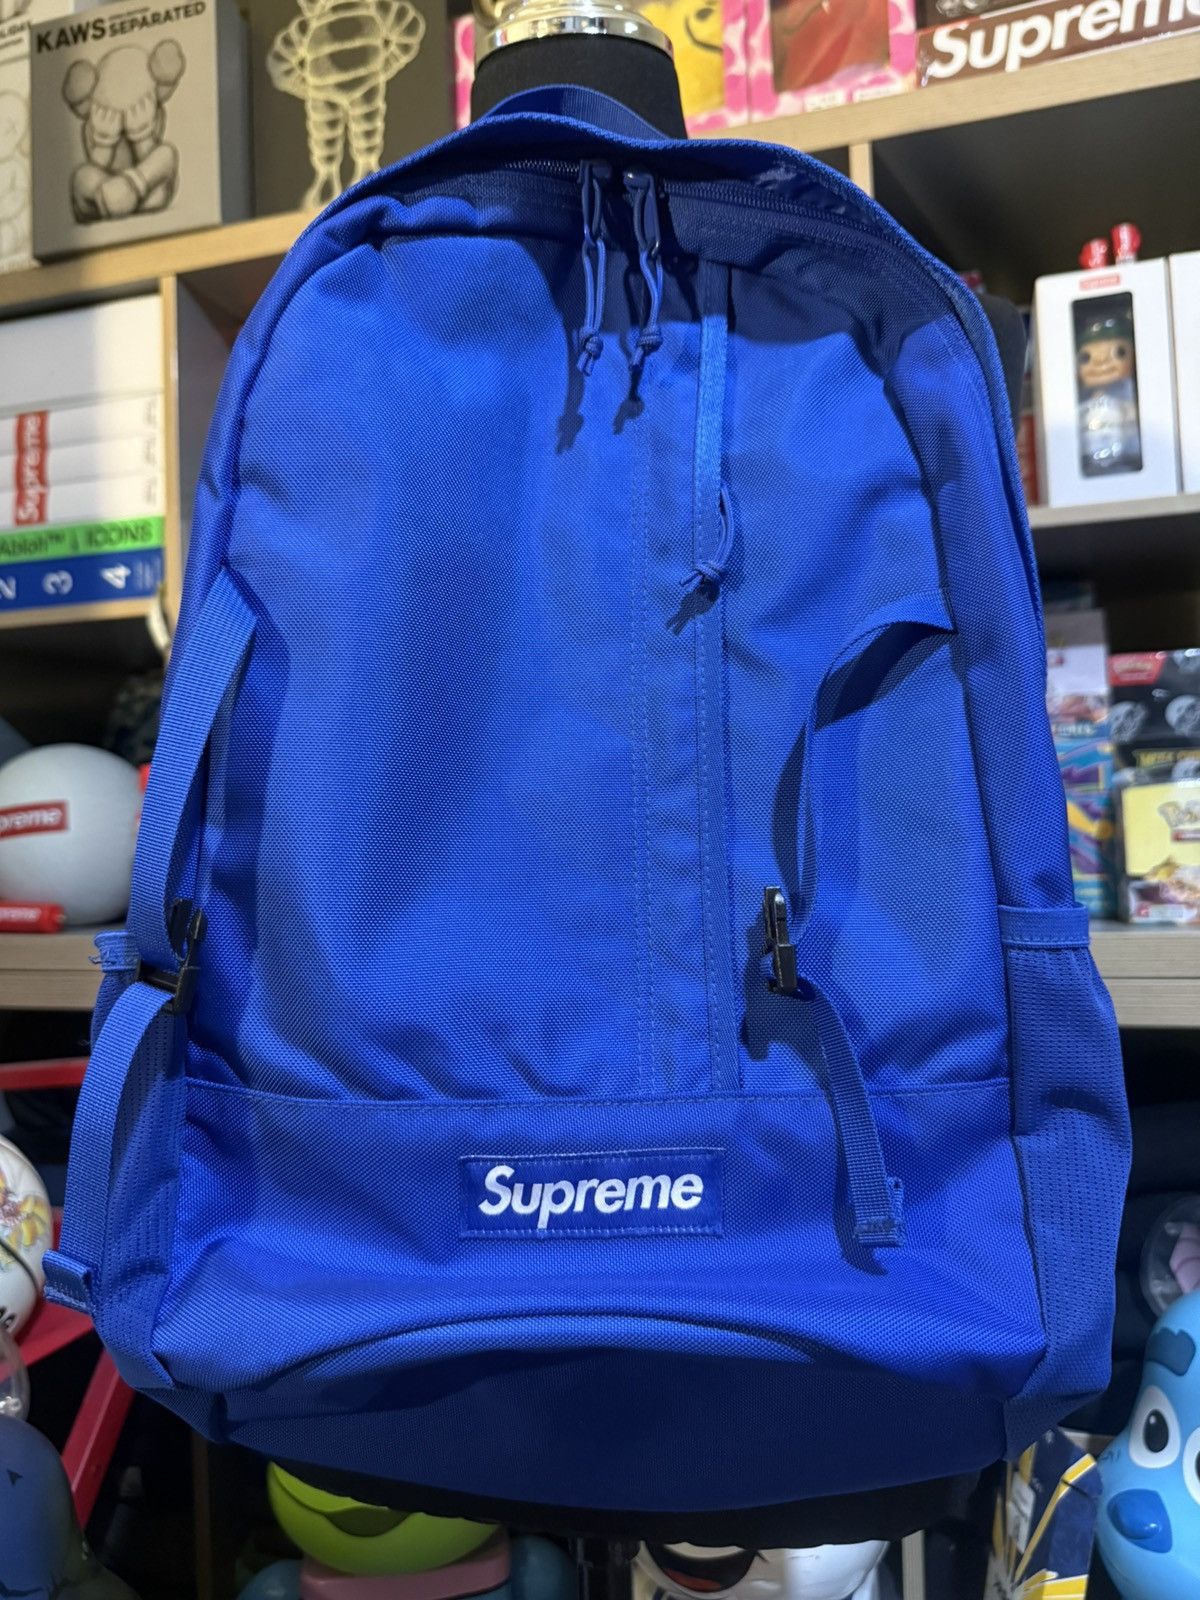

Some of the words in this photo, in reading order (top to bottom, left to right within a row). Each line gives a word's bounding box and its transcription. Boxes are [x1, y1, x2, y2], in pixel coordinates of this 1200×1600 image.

[36, 18, 106, 53] KAWS
[108, 2, 206, 37] SEPARATED
[924, 0, 1200, 78] Suprem
[19, 415, 46, 520] Supreme
[87, 519, 151, 547] ICONS
[101, 563, 131, 590] 4
[478, 1165, 704, 1229] Supreme
